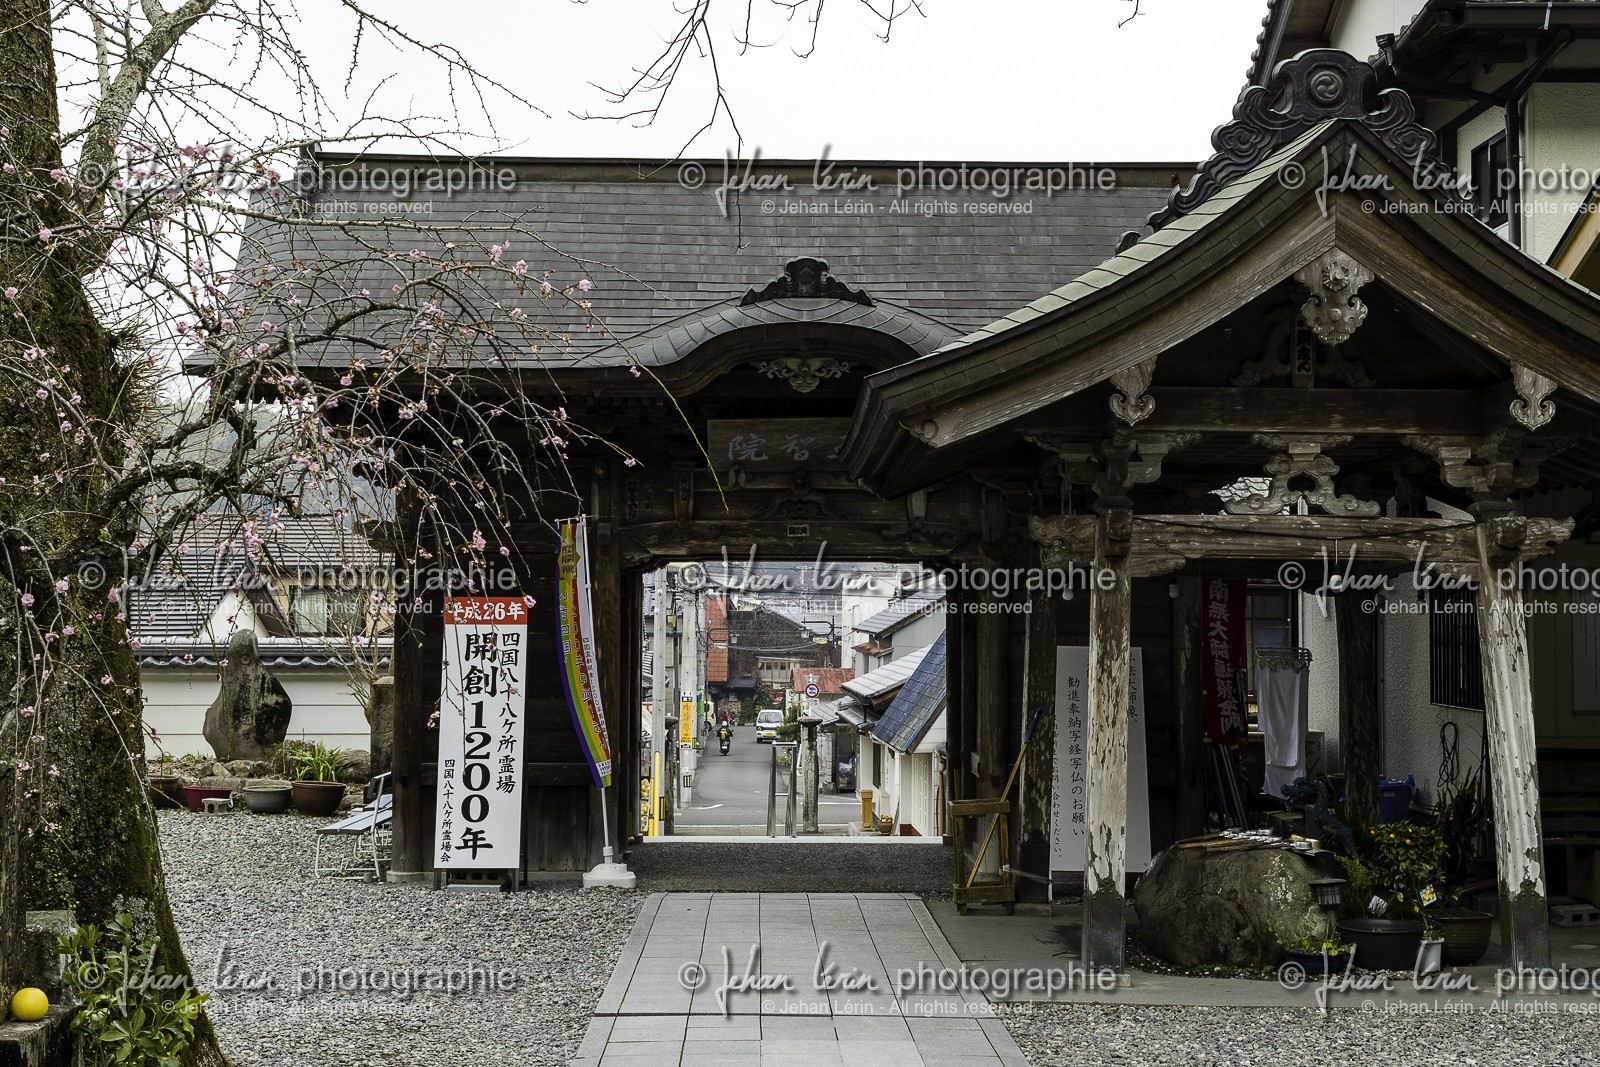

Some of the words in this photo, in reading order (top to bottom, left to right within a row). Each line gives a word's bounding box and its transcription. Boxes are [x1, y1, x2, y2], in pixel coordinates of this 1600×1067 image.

[448, 601, 525, 621] 平成26年
[455, 632, 499, 861] 開創1200年
[1067, 676, 1086, 836] 勧進奉納写経写仏のお願い
